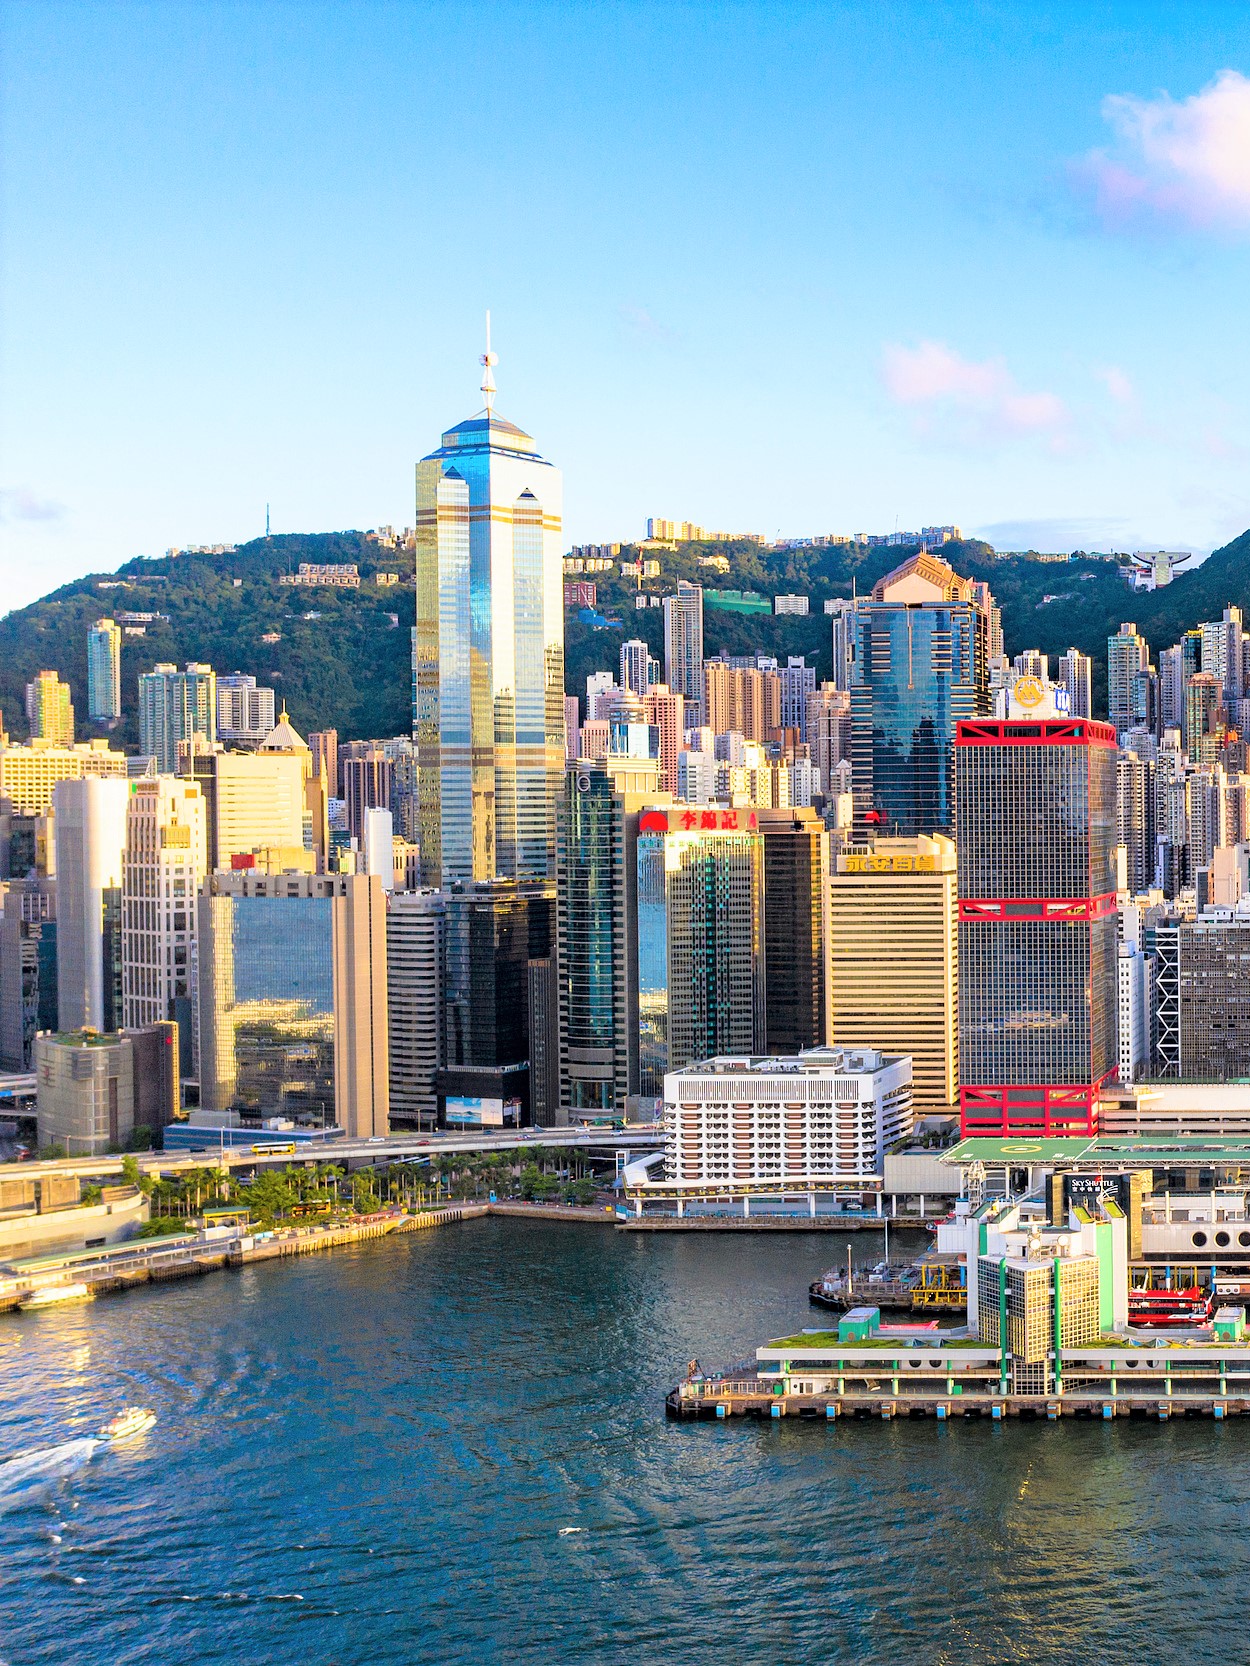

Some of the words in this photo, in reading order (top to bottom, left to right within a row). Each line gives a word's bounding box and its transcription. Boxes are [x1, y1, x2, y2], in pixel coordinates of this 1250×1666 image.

[680, 810, 738, 831] 李錦記
[845, 854, 935, 872] 永安百貨
[1071, 1179, 1085, 1187] SKY
